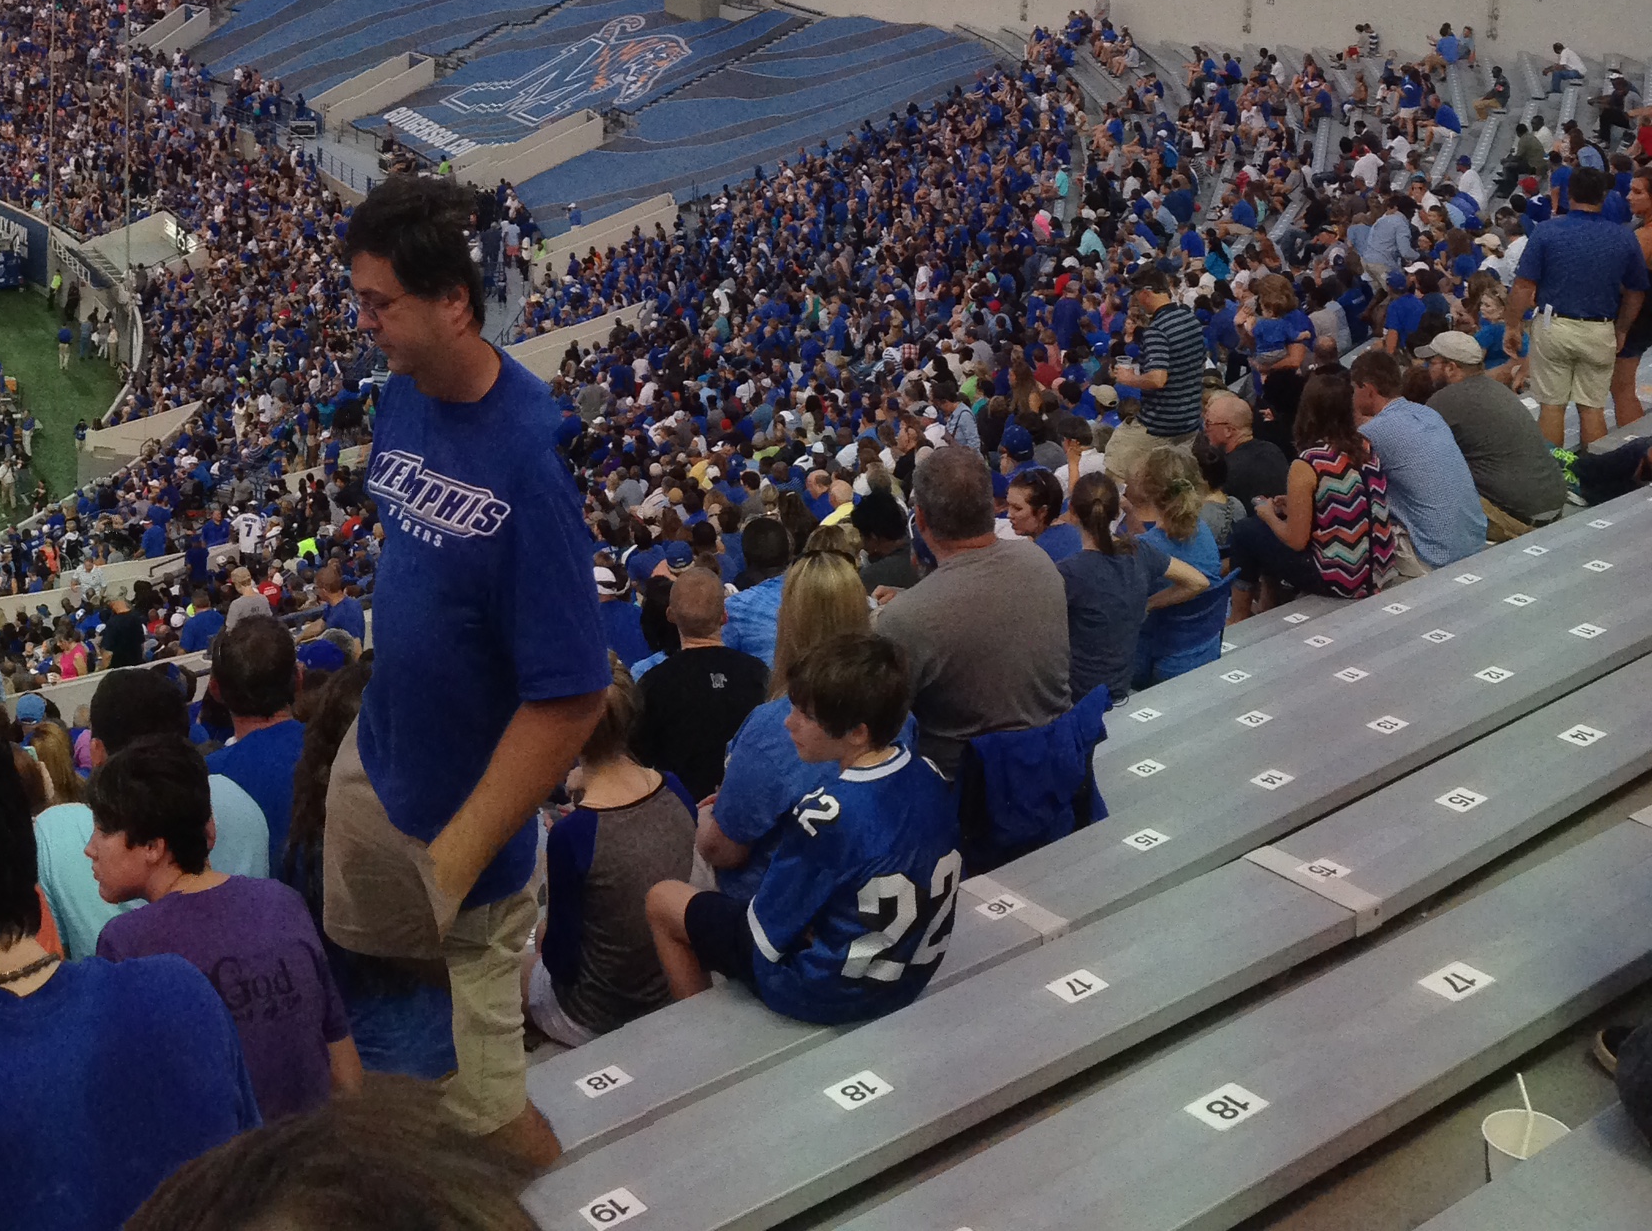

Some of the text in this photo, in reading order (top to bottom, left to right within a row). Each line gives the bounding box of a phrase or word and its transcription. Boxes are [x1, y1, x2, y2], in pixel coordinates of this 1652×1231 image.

[369, 453, 511, 534] MEMPHIS
[244, 523, 253, 537] 7
[388, 504, 443, 547] TIGERS
[1429, 632, 1447, 641] 10
[1577, 627, 1596, 636] 11
[1227, 672, 1245, 681] 10
[1342, 671, 1360, 680] 11
[1484, 671, 1504, 679] 12
[1137, 711, 1154, 719] 11
[1243, 714, 1264, 724] 12
[1377, 721, 1398, 729] 13
[1570, 730, 1594, 741] 14
[1136, 763, 1157, 774] 13
[1261, 775, 1282, 784] 14
[1448, 794, 1475, 807] 15
[1134, 834, 1158, 846] 15
[988, 900, 1014, 914] 16
[841, 849, 962, 982] 22
[1066, 979, 1092, 996] 17
[1443, 973, 1476, 993] 17
[587, 1073, 618, 1090] 18
[841, 1081, 877, 1101] 18
[1206, 1095, 1249, 1119] 18
[590, 1199, 629, 1222] 19
